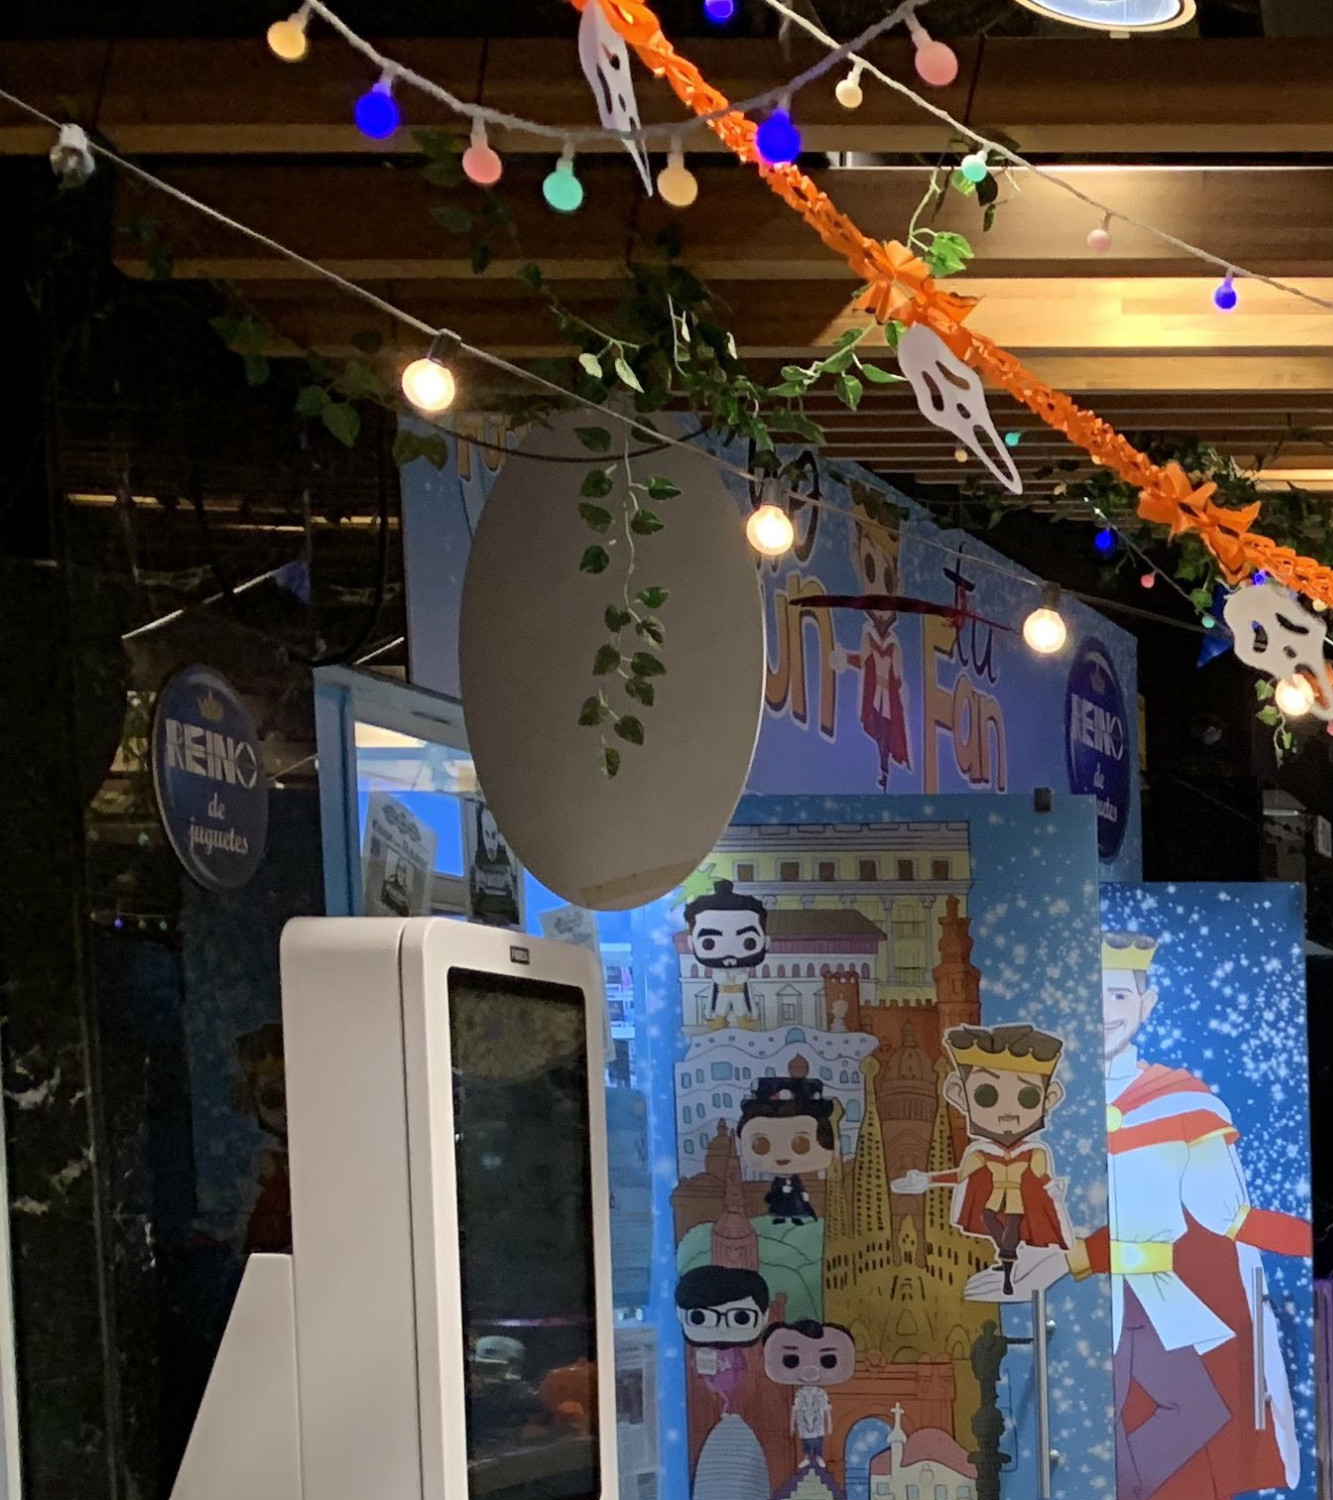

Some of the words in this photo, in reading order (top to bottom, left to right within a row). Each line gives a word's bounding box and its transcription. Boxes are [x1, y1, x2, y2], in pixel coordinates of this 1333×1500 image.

[165, 718, 259, 789] REINO
[1069, 692, 1125, 761] REINO
[207, 792, 226, 820] de
[189, 816, 249, 856] juguetes
